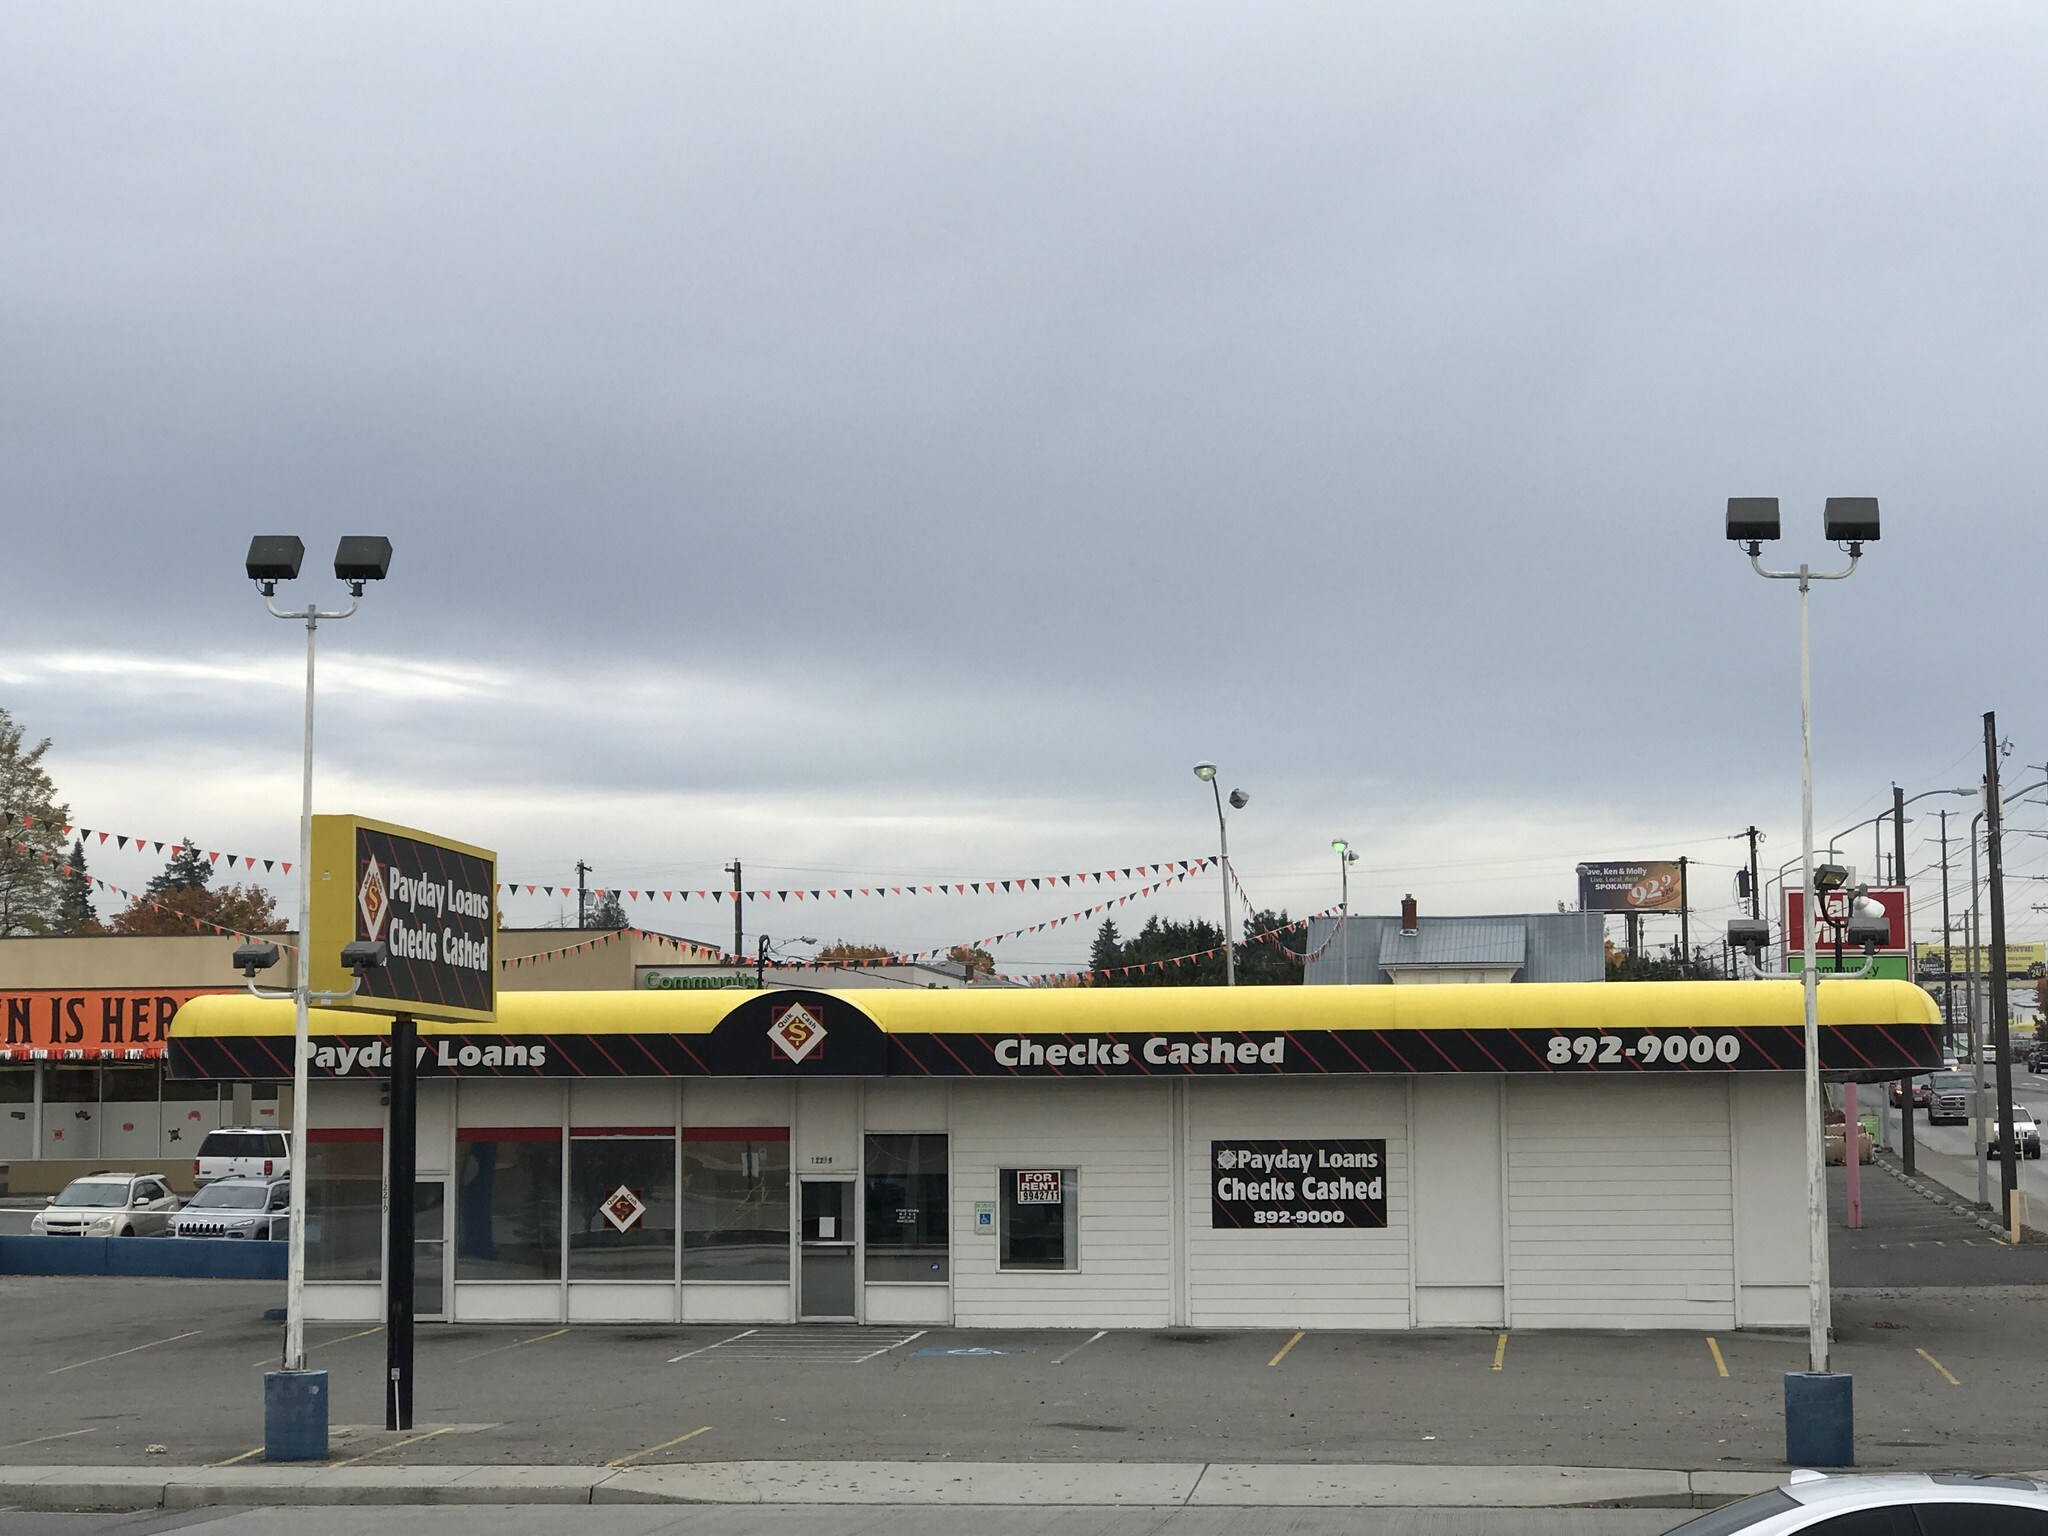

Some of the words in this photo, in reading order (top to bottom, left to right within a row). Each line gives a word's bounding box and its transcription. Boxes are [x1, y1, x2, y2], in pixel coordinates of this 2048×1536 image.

[1626, 867, 1647, 876] Molly
[389, 866, 445, 918] Payday
[447, 879, 489, 920] Loans
[1595, 883, 1633, 891] SPOKANE
[389, 917, 437, 962] Checks
[442, 927, 488, 971] Cashed
[2005, 945, 2034, 954] ONTH!
[645, 971, 759, 989] Community
[0, 998, 33, 1044] N
[50, 997, 85, 1044] IS
[100, 996, 190, 1044] HER
[777, 1012, 793, 1029] Quik
[801, 1012, 817, 1029] Cash
[438, 1040, 546, 1067] Loans
[994, 1038, 1130, 1066] Checks
[1143, 1037, 1285, 1065] Cashed
[1546, 1034, 1741, 1065] 892-9000
[1238, 1149, 1313, 1173] Payday
[1318, 1149, 1378, 1168] Loans
[1021, 1182, 1057, 1191] RENT
[1025, 1173, 1053, 1182] FOR
[1023, 1191, 1060, 1201] 9942711
[1217, 1177, 1295, 1201] Checks
[1302, 1176, 1382, 1200] Cashed
[1253, 1210, 1345, 1224] 892-9000
